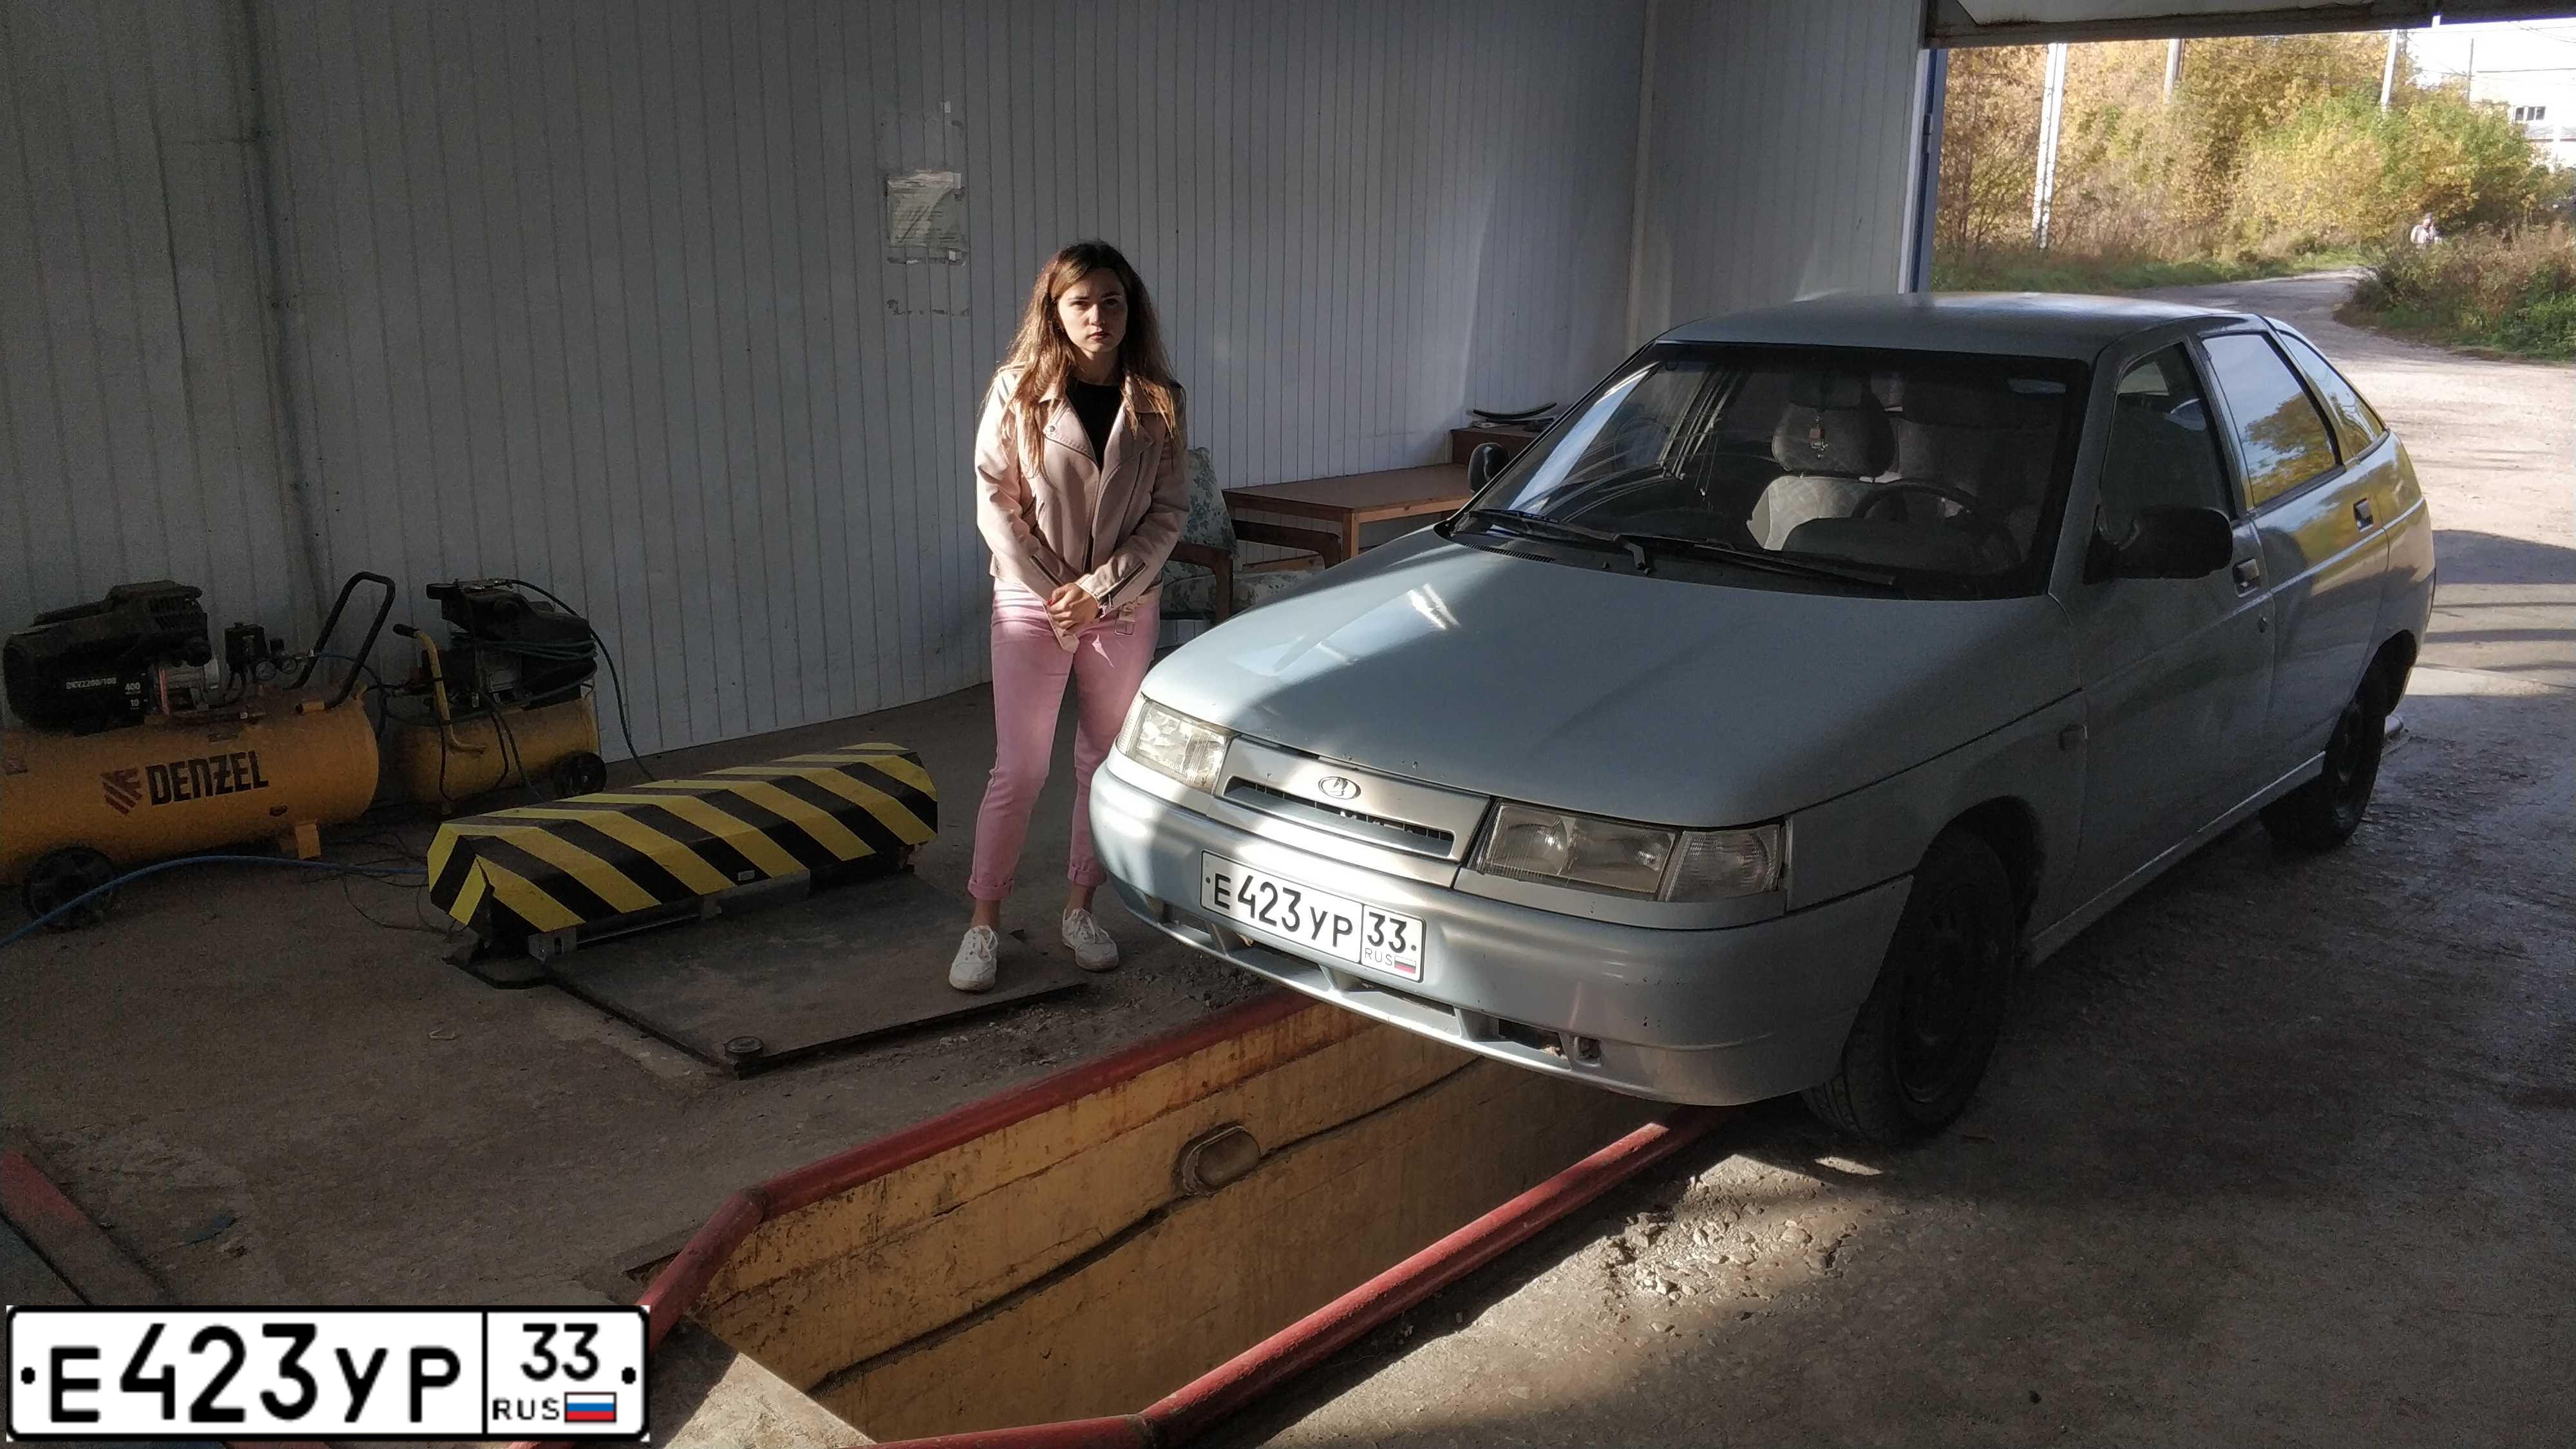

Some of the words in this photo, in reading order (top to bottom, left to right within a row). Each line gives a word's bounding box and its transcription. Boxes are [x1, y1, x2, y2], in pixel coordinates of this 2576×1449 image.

[145, 750, 269, 806] DENZEL
[1367, 912, 1406, 954] 33
[1365, 948, 1392, 966] RUS
